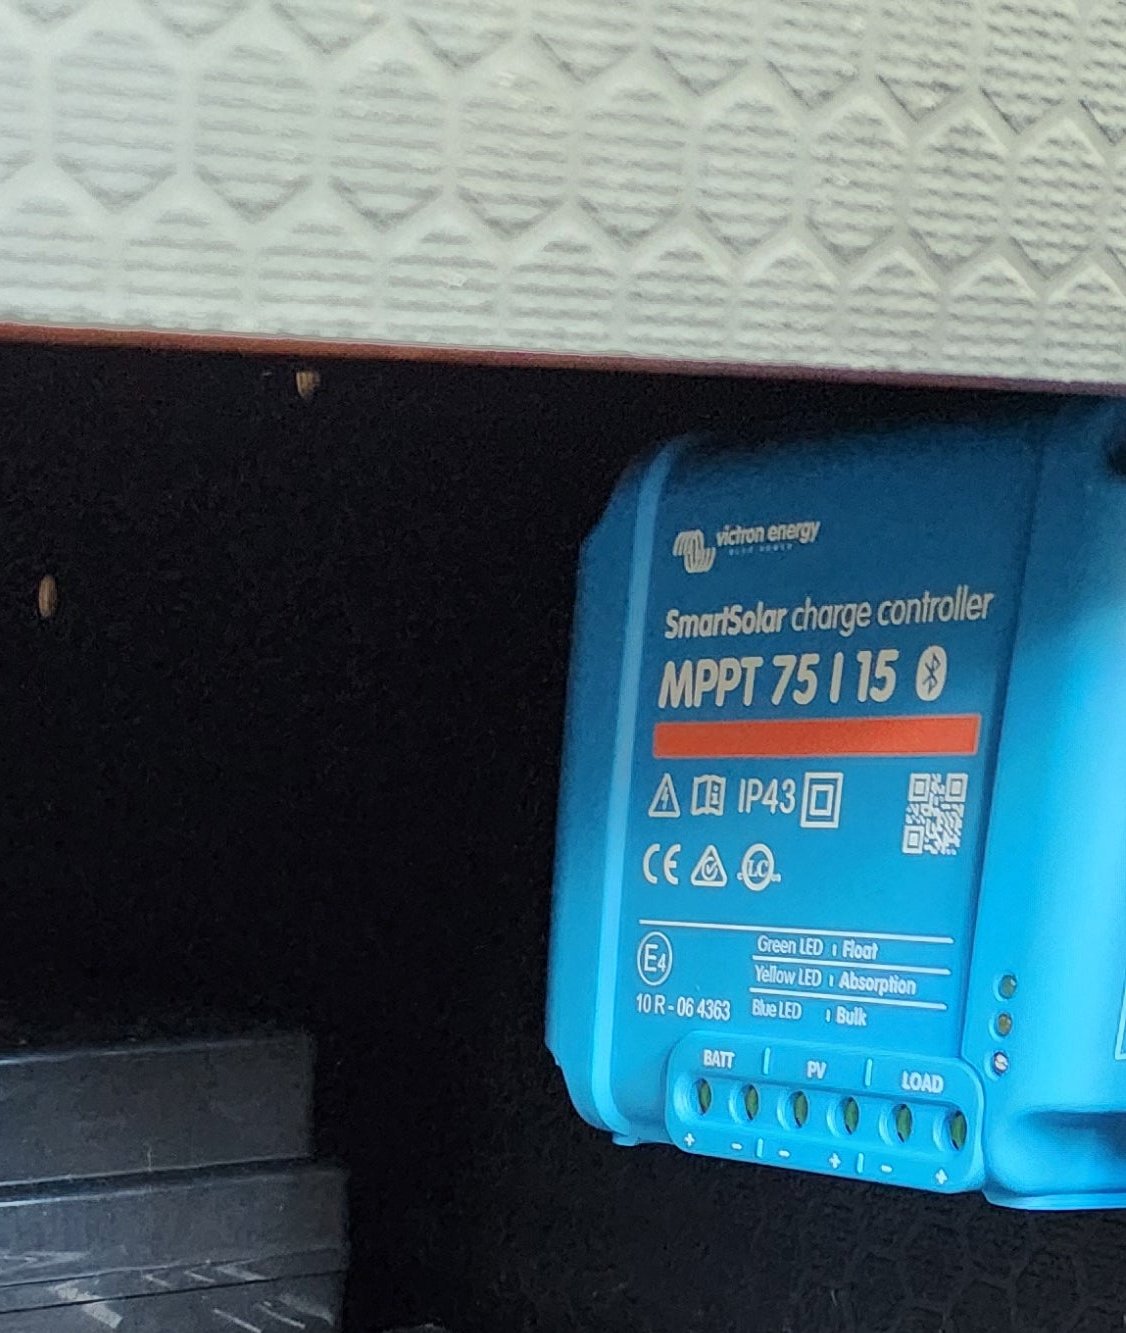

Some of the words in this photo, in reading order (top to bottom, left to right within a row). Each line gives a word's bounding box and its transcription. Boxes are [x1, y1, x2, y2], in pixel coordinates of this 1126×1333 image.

[716, 524, 765, 547] victron
[767, 520, 821, 544] energy
[665, 601, 787, 639] SmartSolar
[791, 596, 872, 637] charge
[877, 585, 995, 626] controller
[658, 656, 763, 709] MPPT
[771, 653, 821, 706] 75
[857, 649, 900, 703] 15
[737, 778, 796, 814] IP43
[757, 934, 797, 955] Green
[798, 937, 824, 957] LED
[842, 939, 879, 960] Float
[755, 964, 796, 984] Yellow
[798, 967, 822, 987] LED
[839, 972, 917, 997] Absorption
[636, 993, 652, 1013] 10
[654, 994, 666, 1014] R
[677, 996, 694, 1018] 06
[696, 997, 731, 1021] 4363
[752, 998, 778, 1018] Blue
[779, 1000, 803, 1020] LED
[836, 1006, 867, 1027] Bulk
[703, 1049, 735, 1069] BATT
[806, 1060, 826, 1079] PV
[902, 1071, 944, 1093] LOAD
